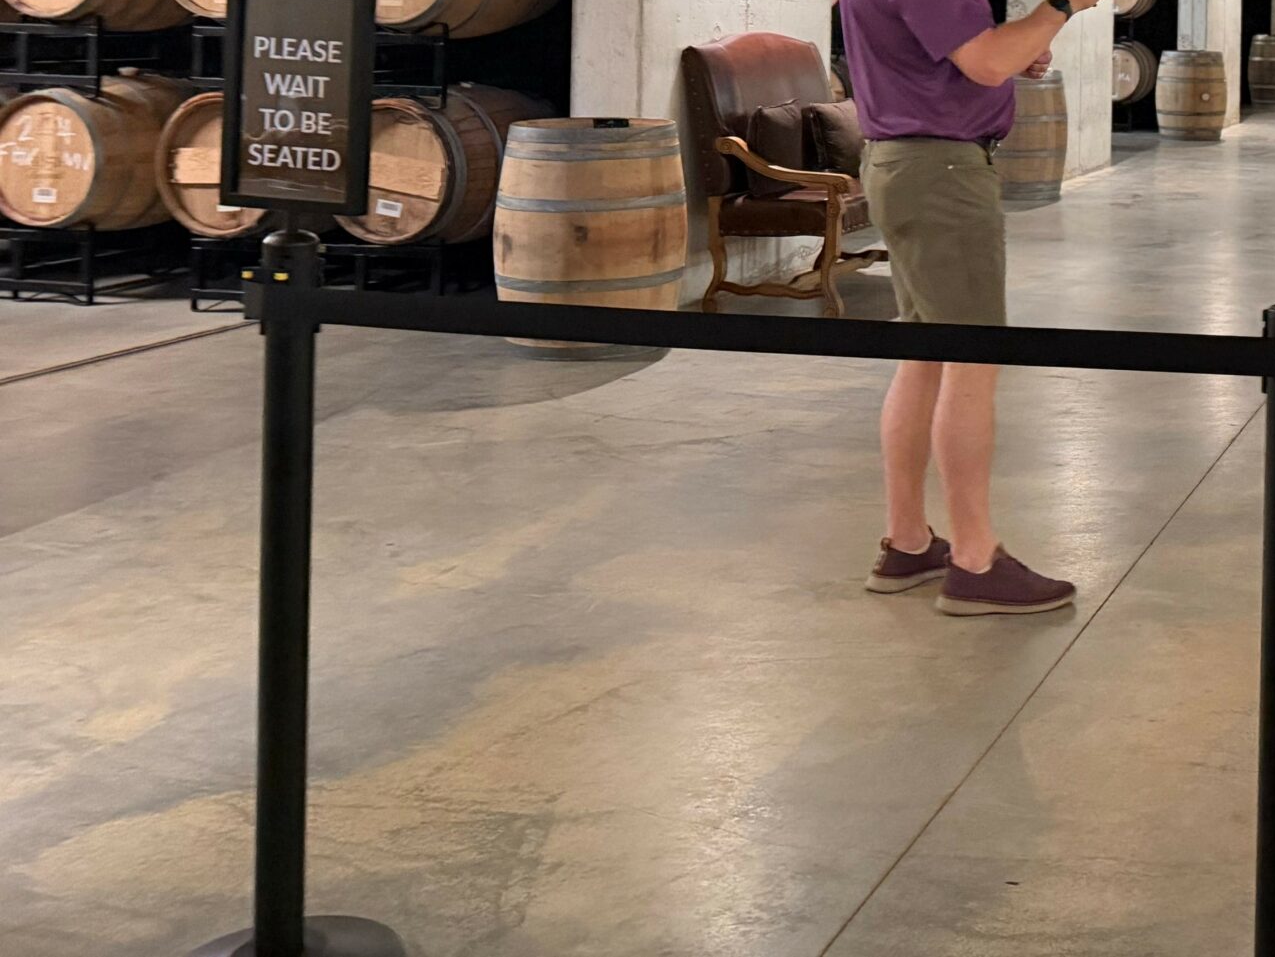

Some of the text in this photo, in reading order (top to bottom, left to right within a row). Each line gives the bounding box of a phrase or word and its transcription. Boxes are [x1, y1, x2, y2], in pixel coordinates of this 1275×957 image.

[253, 36, 343, 63] PLEASE
[263, 72, 330, 98] WAIT
[258, 108, 332, 135] TO BE
[247, 143, 341, 172] SEATED
